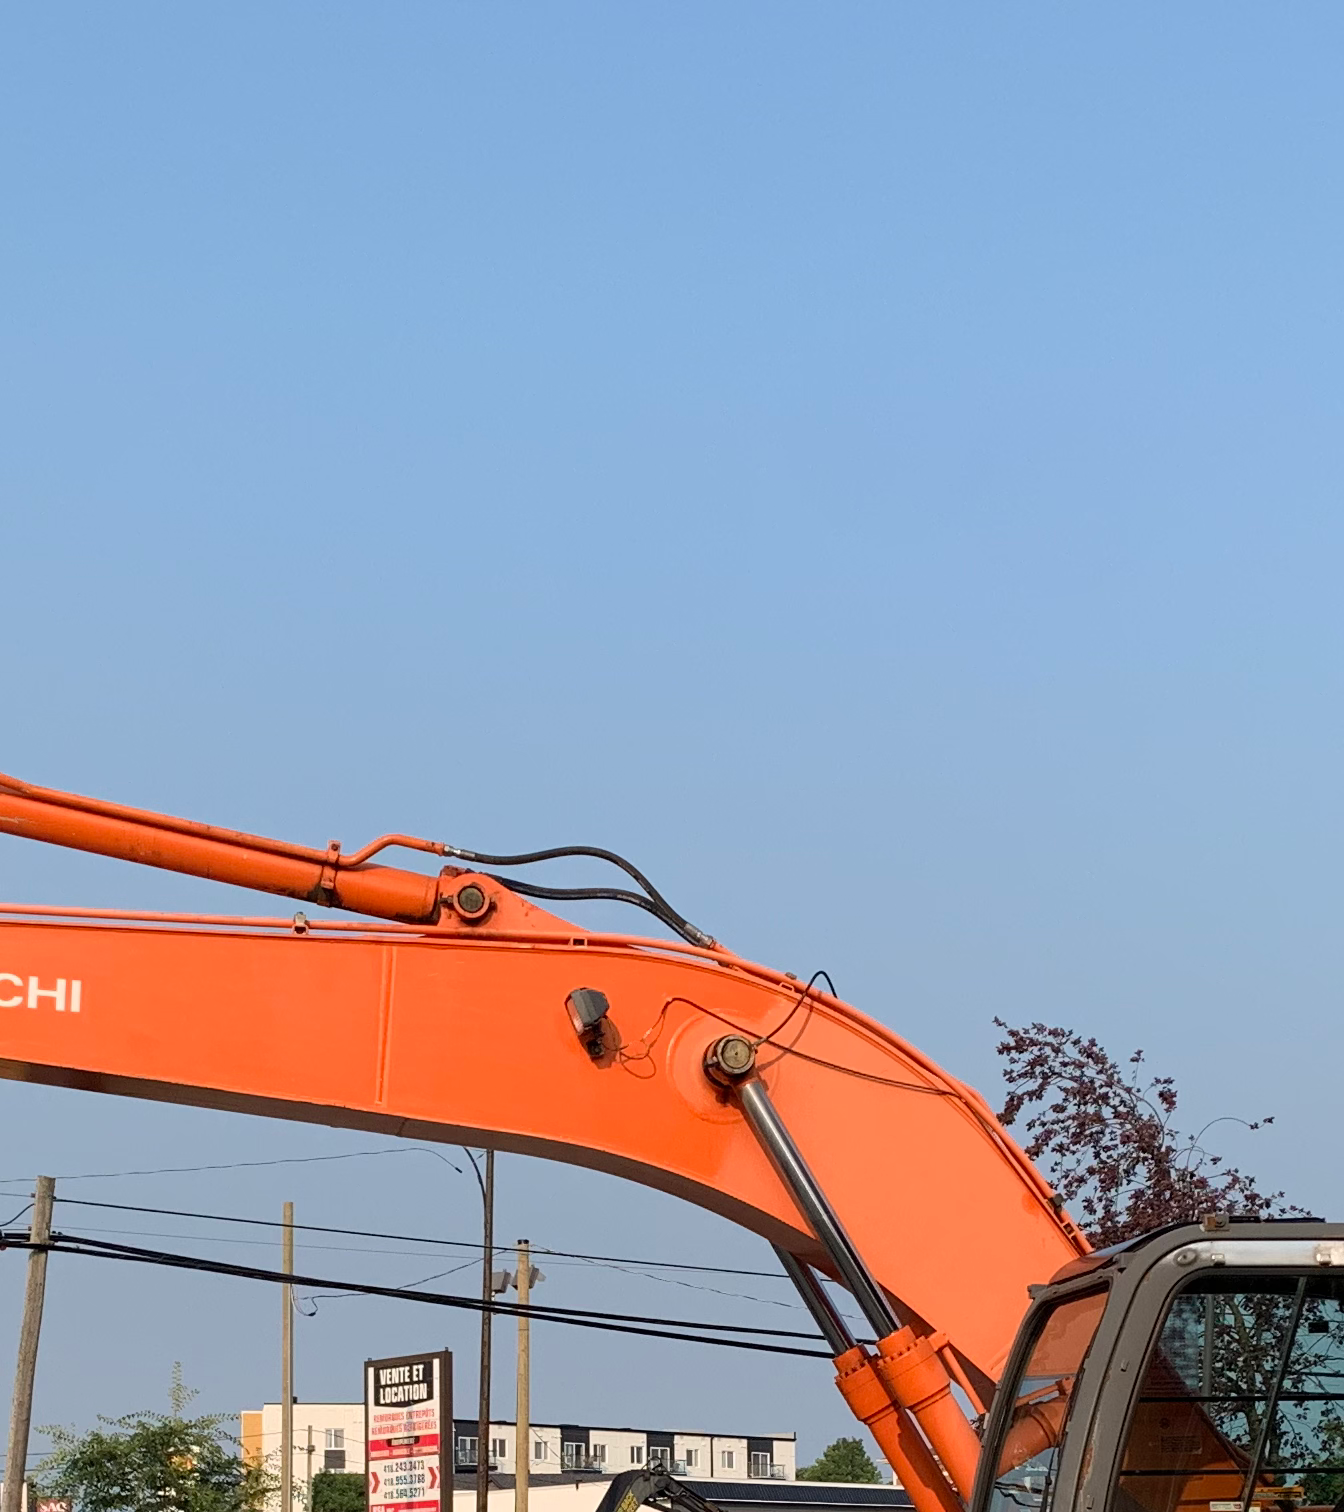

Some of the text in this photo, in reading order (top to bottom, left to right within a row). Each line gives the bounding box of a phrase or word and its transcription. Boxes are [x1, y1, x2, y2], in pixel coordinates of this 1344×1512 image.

[379, 1364, 424, 1386] VENTE ET
[379, 1383, 428, 1404] LOCATION
[39, 1502, 68, 1512] SAQ
